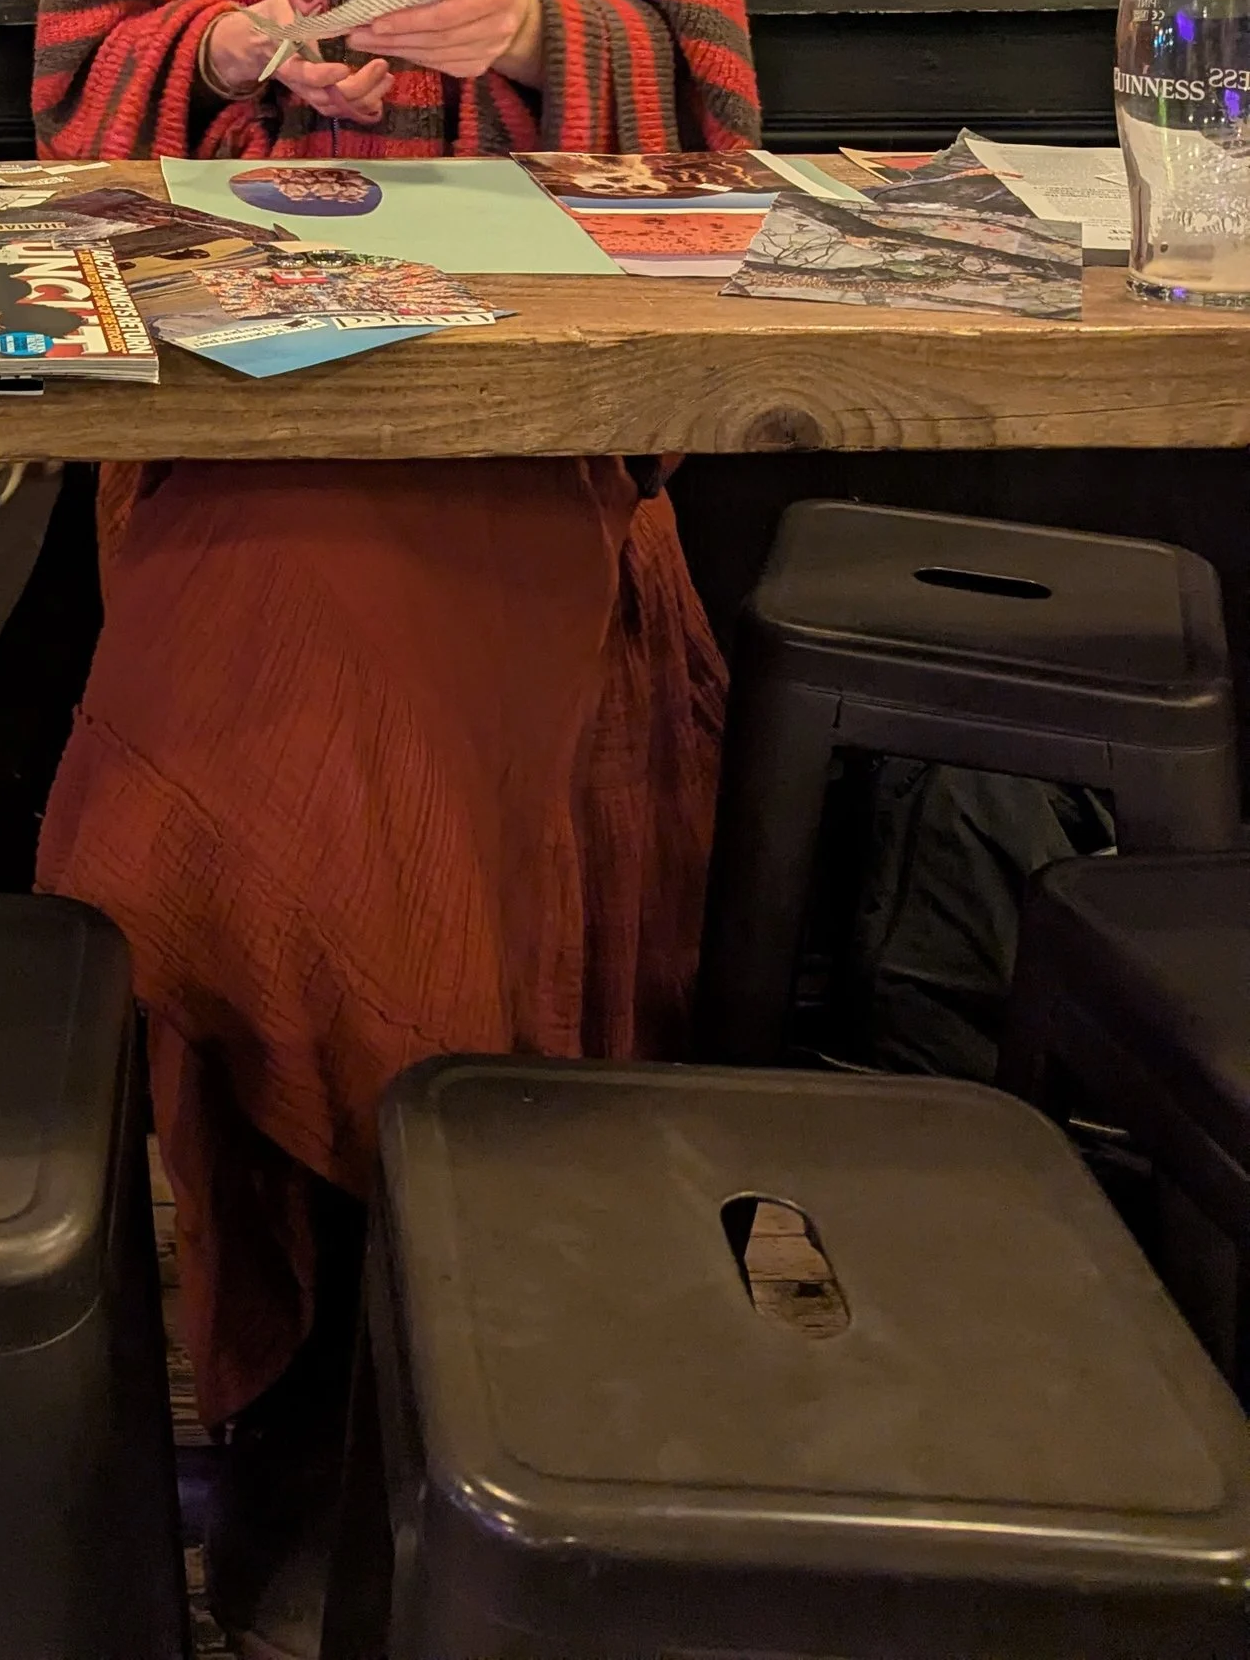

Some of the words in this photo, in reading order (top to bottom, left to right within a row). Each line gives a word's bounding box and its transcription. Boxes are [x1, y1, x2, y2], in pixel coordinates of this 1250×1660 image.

[91, 250, 121, 279] ARCTIC
[101, 279, 138, 316] MONKEYS
[117, 317, 153, 354] RETURN
